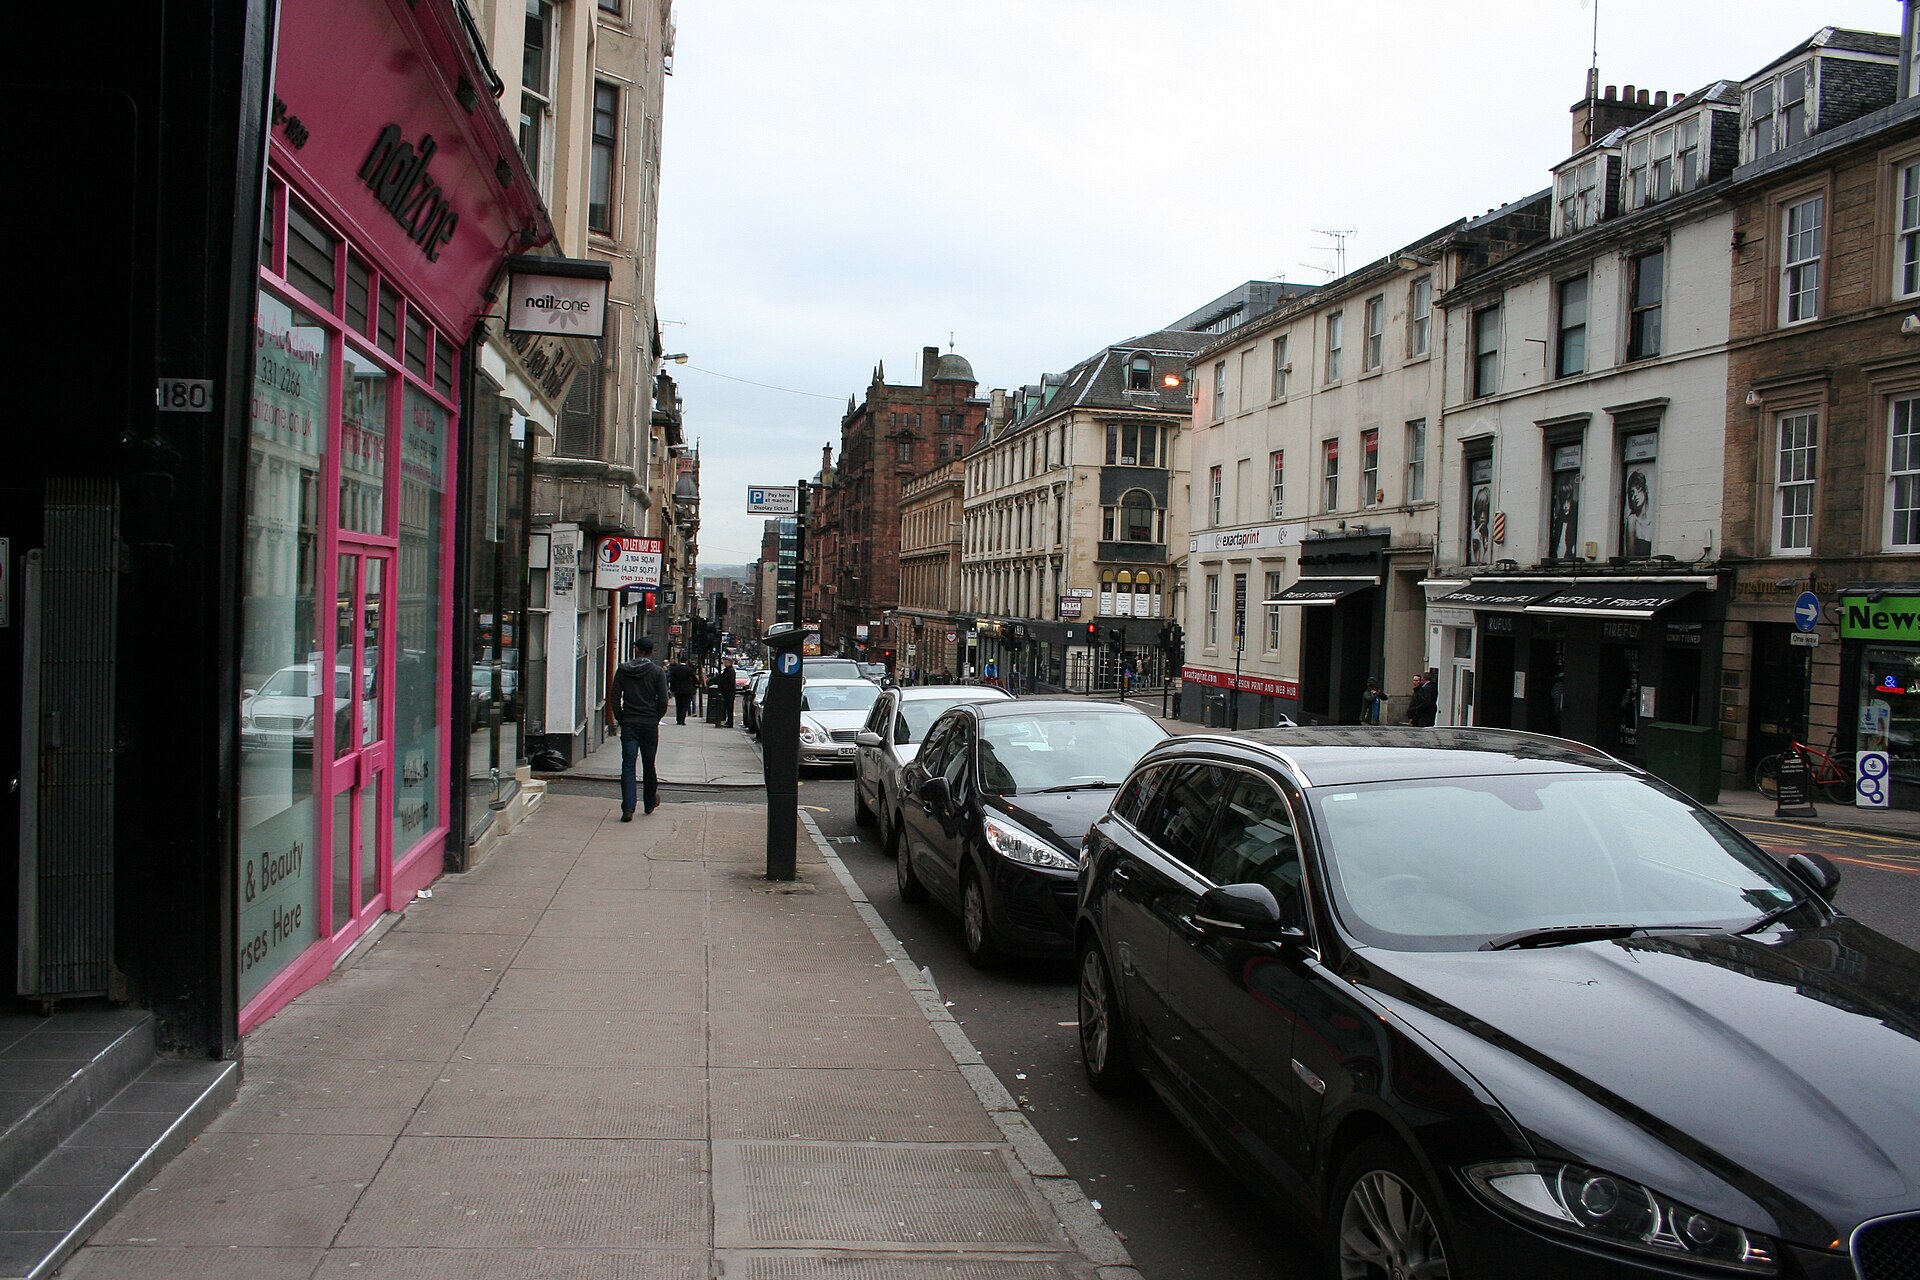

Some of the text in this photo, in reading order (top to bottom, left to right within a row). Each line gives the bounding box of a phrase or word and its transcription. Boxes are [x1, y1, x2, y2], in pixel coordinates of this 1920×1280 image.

[357, 123, 459, 264] nailzone
[525, 295, 590, 312] nailzone
[269, 312, 321, 377] Academy
[261, 356, 301, 398] 331 2266
[163, 382, 205, 408] 180
[753, 492, 762, 503] P
[622, 538, 661, 553] TO LET MAY SELL
[1222, 530, 1260, 548] exactaprint
[641, 556, 655, 564] SQ.M
[1802, 582, 1836, 594] HUSE
[1445, 593, 1485, 602] RUFUS
[1490, 595, 1539, 603] FIREFLY
[1548, 596, 1675, 607] RUFUS T FIREFLY
[1488, 617, 1513, 632] RUFUS
[1849, 605, 1920, 630] New
[1603, 622, 1641, 639] FIREFLY
[784, 653, 798, 673] P
[1227, 677, 1296, 696] THE ESIGN PRINT AND WEB HUB
[401, 801, 429, 834] Welcome
[246, 840, 304, 903] & Beauty
[272, 903, 301, 948] Here
